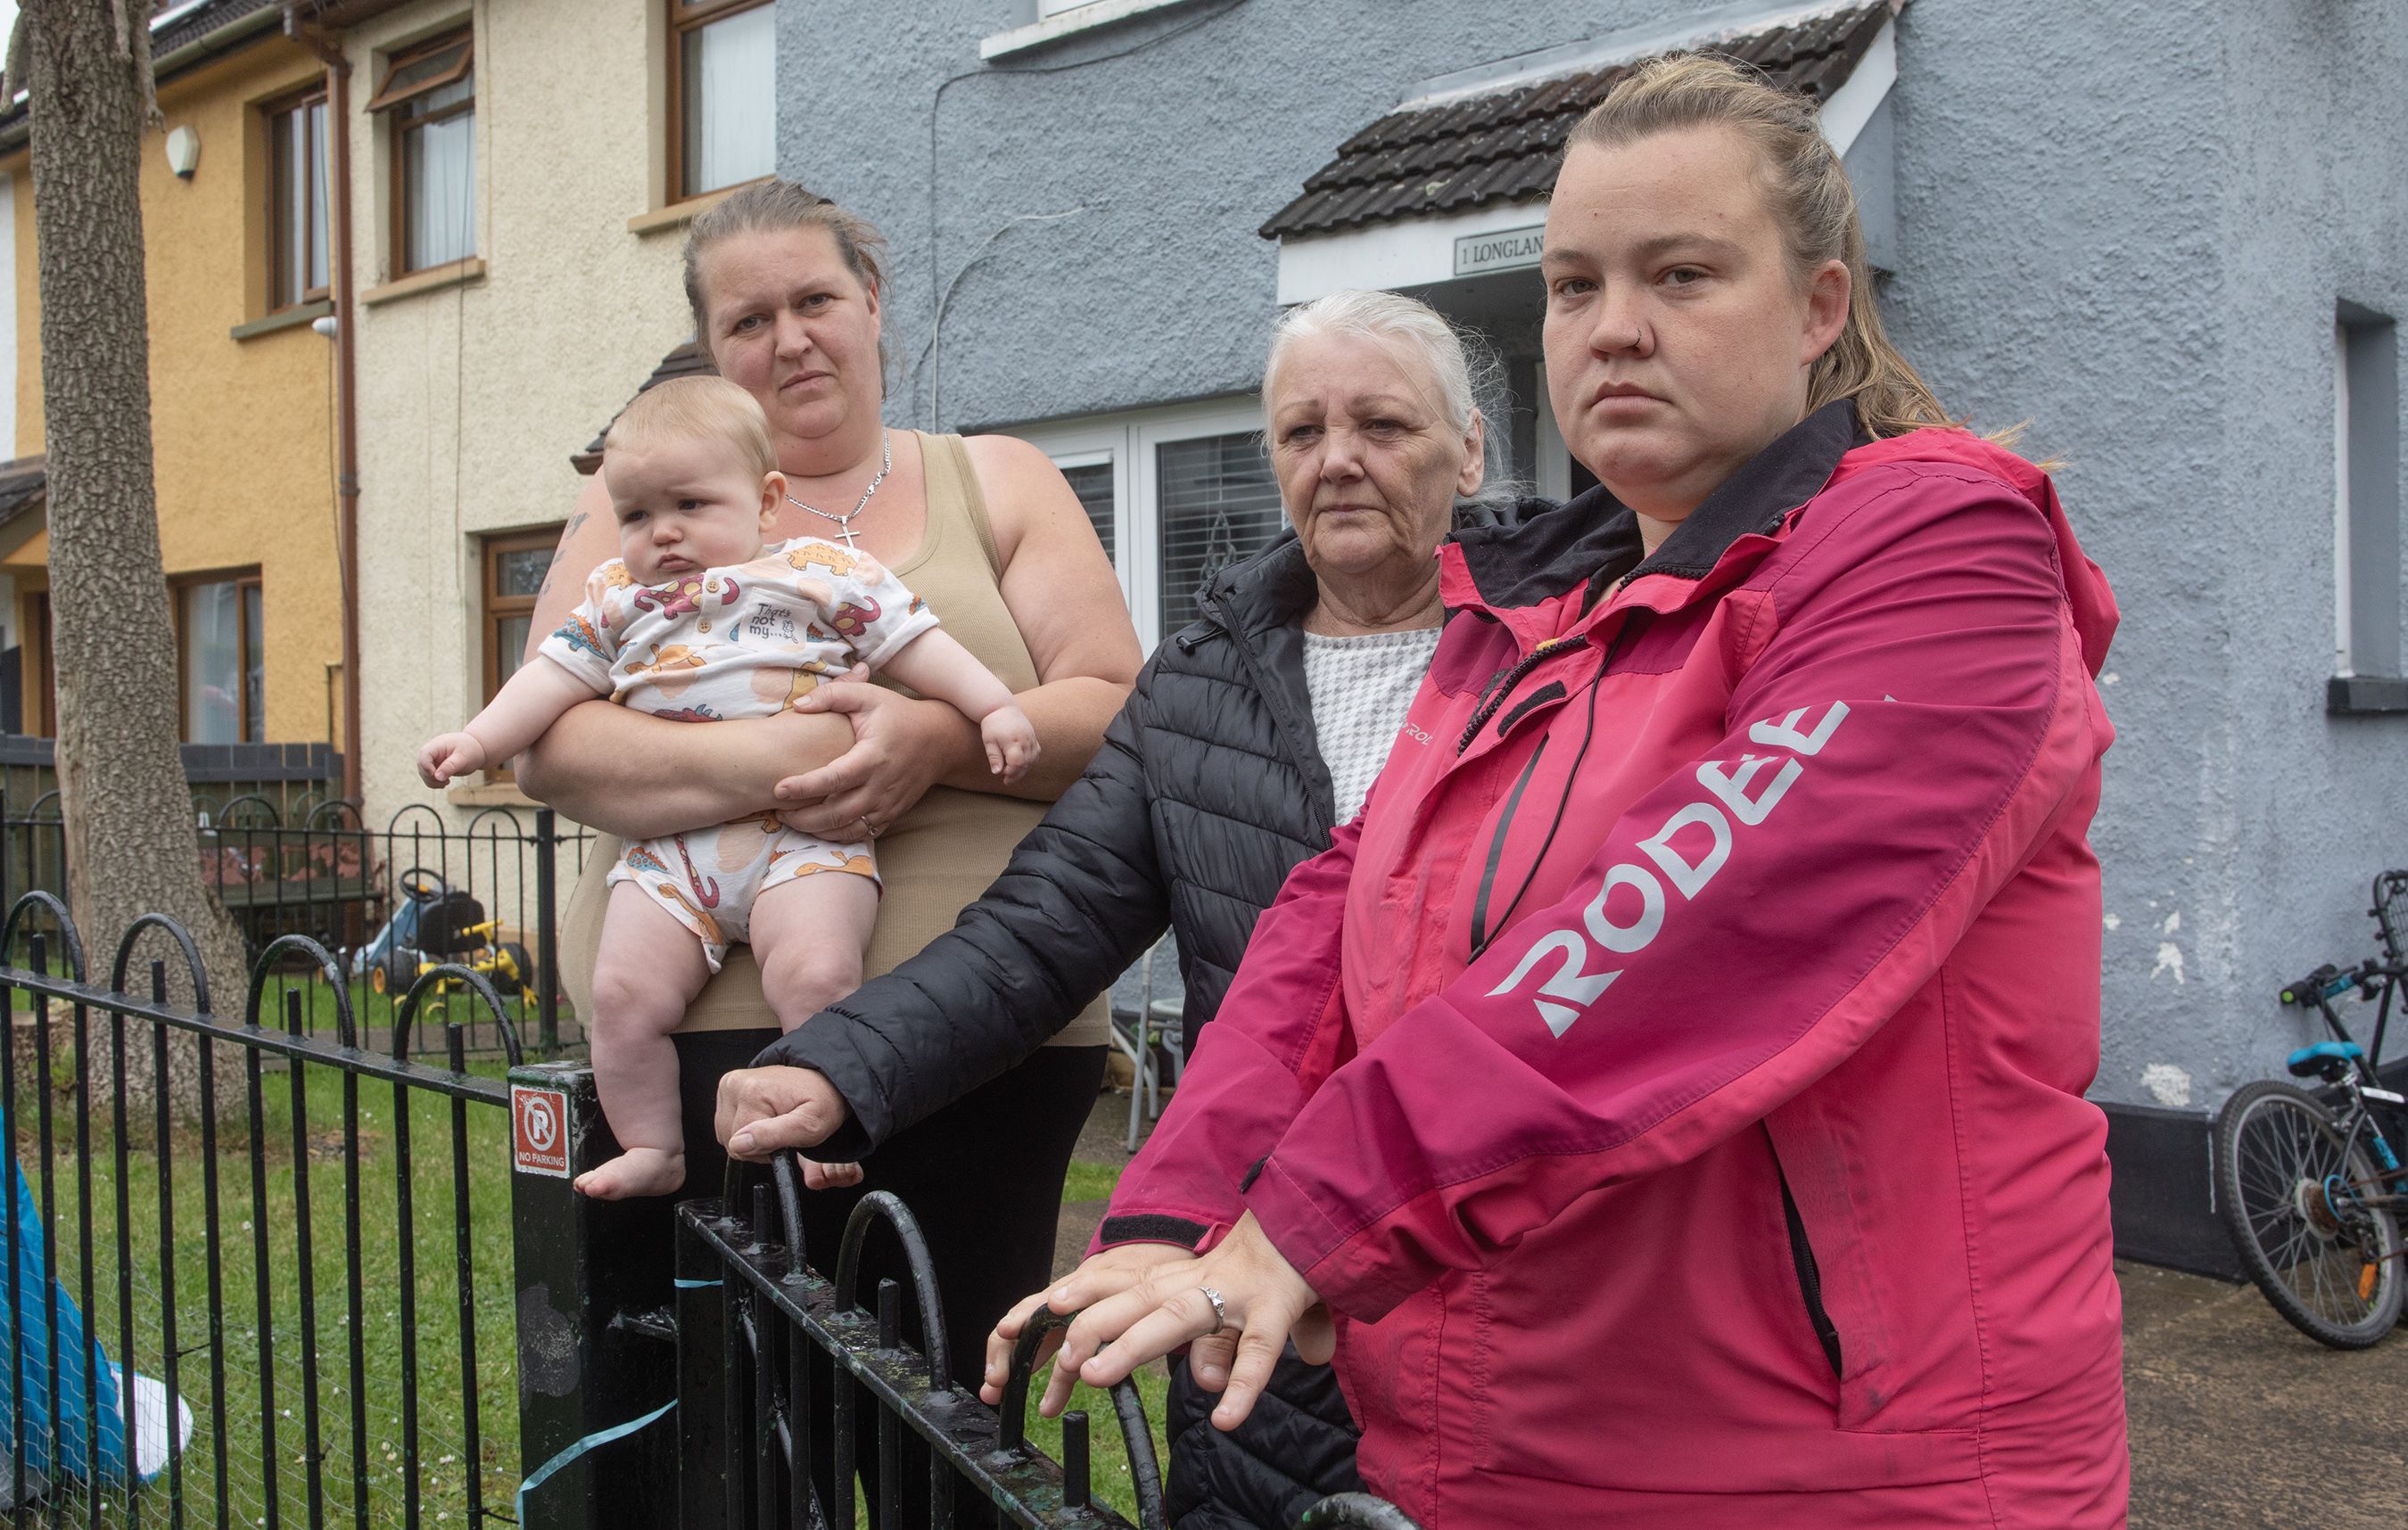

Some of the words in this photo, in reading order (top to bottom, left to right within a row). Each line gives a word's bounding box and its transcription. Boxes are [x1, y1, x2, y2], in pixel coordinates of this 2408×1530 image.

[1463, 248, 1467, 264] 1
[752, 615, 776, 626] not
[1484, 699, 1853, 1040] RODEE
[519, 1152, 531, 1162] NO
[532, 1154, 565, 1167] PARKING
